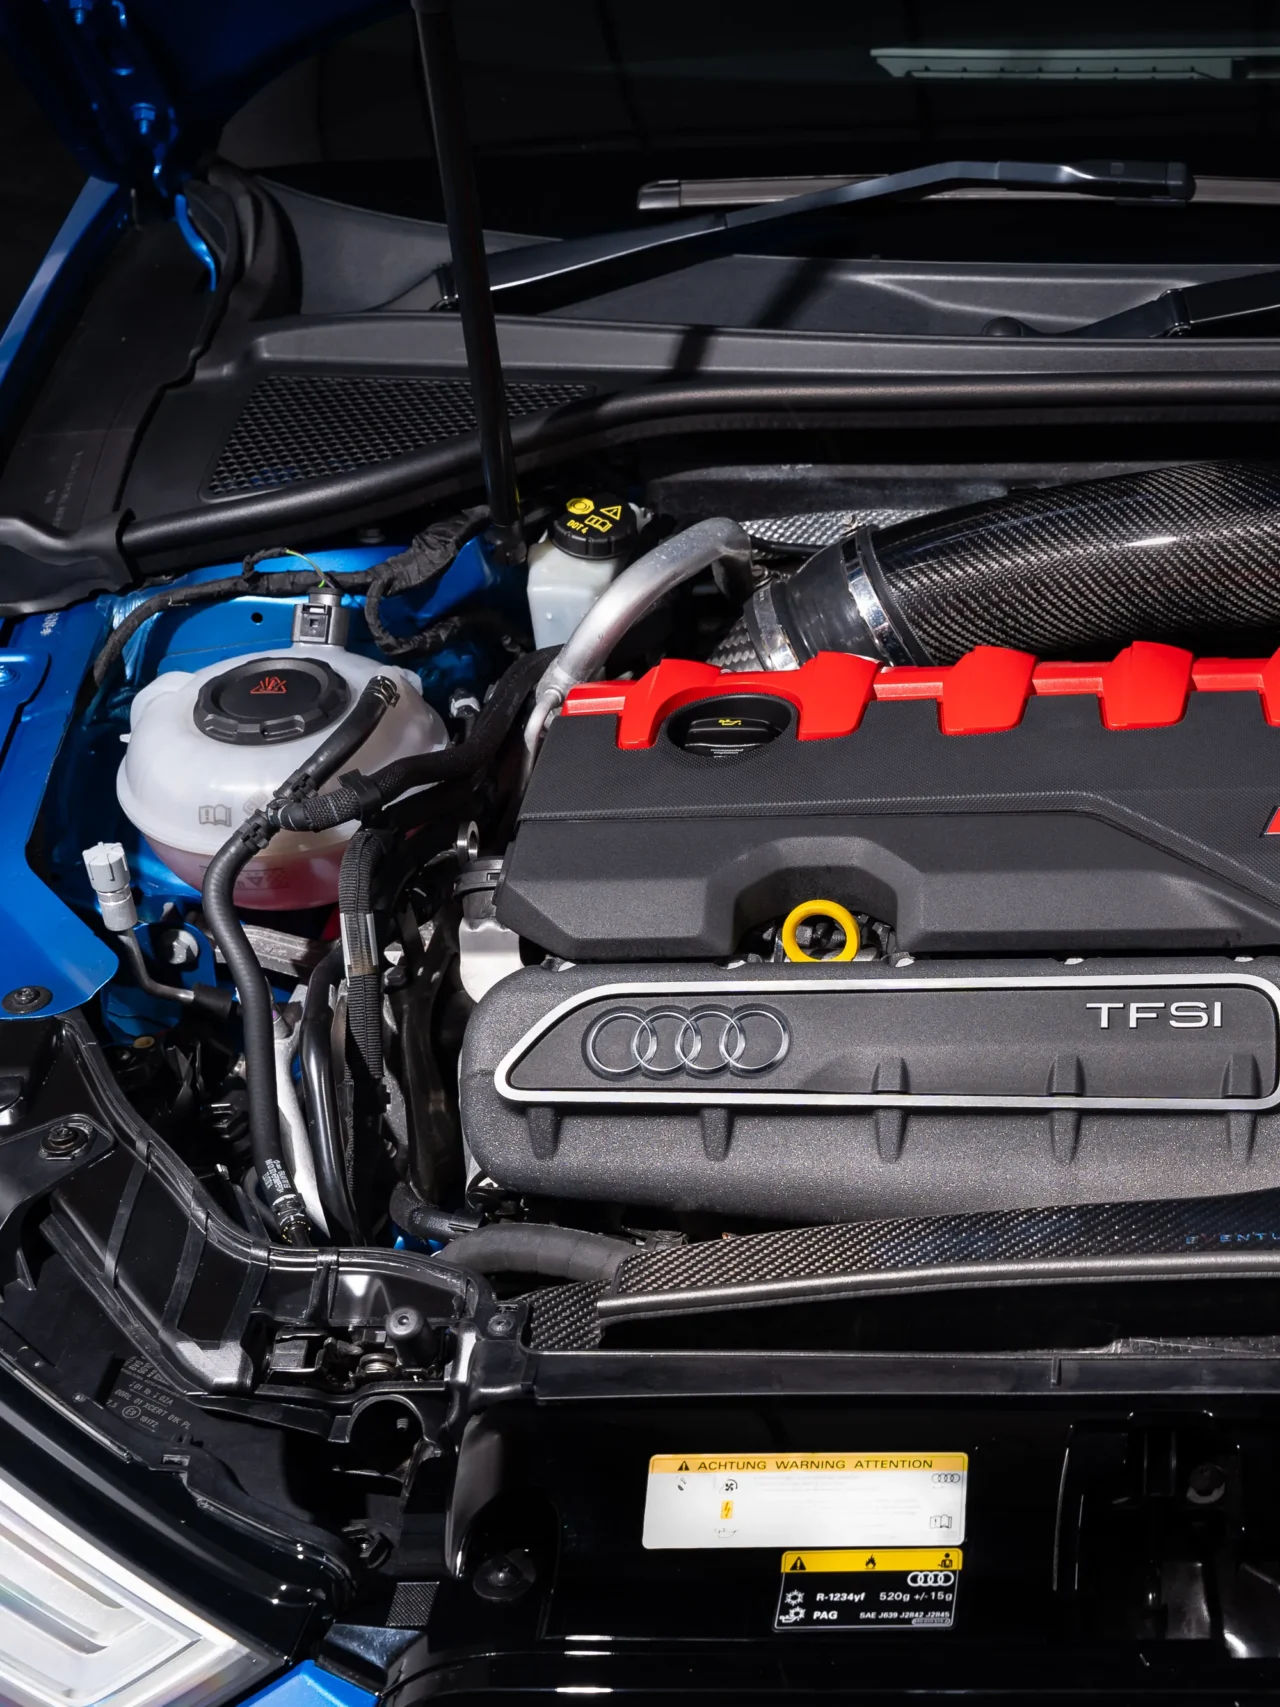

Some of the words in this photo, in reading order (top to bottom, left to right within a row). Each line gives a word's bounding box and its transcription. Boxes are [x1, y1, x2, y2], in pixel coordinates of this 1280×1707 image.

[566, 519, 584, 531] DOT
[581, 526, 589, 535] 4
[1086, 1001, 1222, 1029] TFSI
[697, 1460, 767, 1471] ACHTUNG
[776, 1459, 846, 1470] WARNING
[854, 1459, 934, 1469] ATTENTION
[816, 1592, 867, 1603] R-1234yf
[879, 1591, 910, 1602] 520g
[813, 1610, 839, 1620] PAG
[859, 1611, 877, 1619] SAE
[879, 1611, 898, 1619] J639
[900, 1611, 924, 1619] J2842
